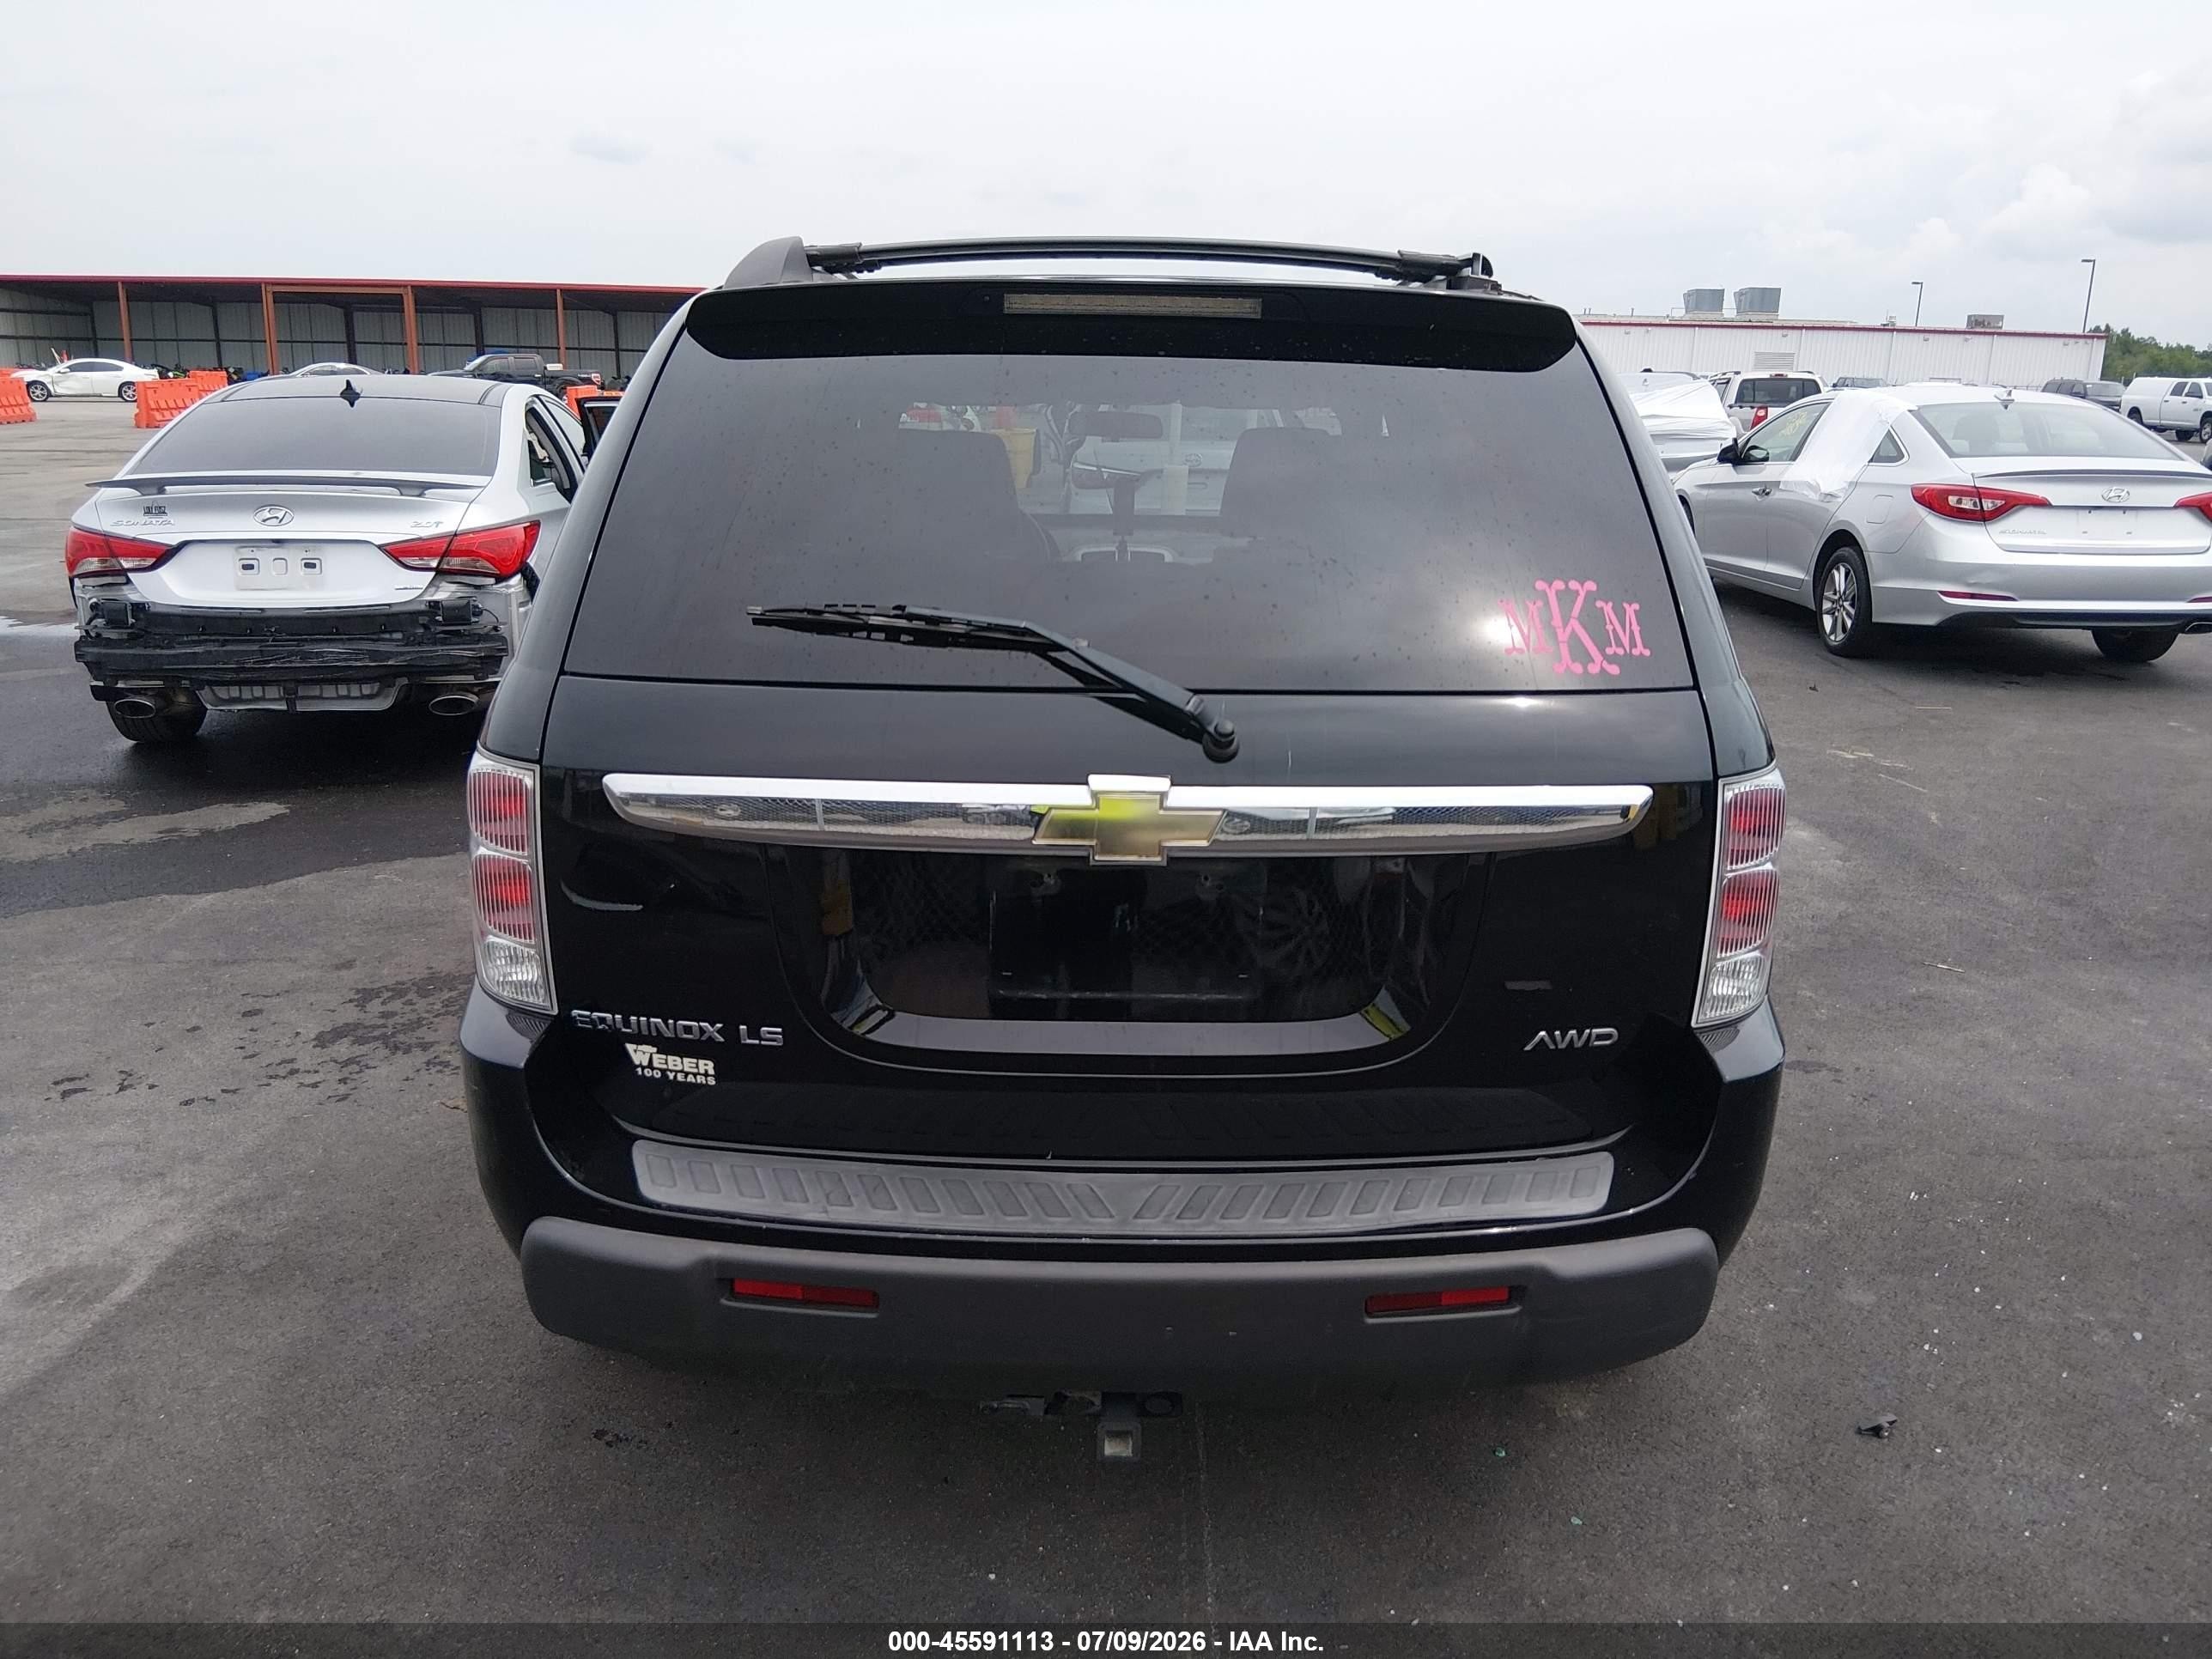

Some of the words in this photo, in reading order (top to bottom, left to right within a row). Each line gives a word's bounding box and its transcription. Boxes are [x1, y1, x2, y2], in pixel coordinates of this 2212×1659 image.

[570, 1010, 726, 1042] EQUINOX
[739, 1024, 784, 1047] LS
[1523, 1028, 1619, 1051] AWD
[624, 1042, 715, 1075] WEBER
[635, 1066, 662, 1079] 100
[666, 1071, 716, 1085] YEARS
